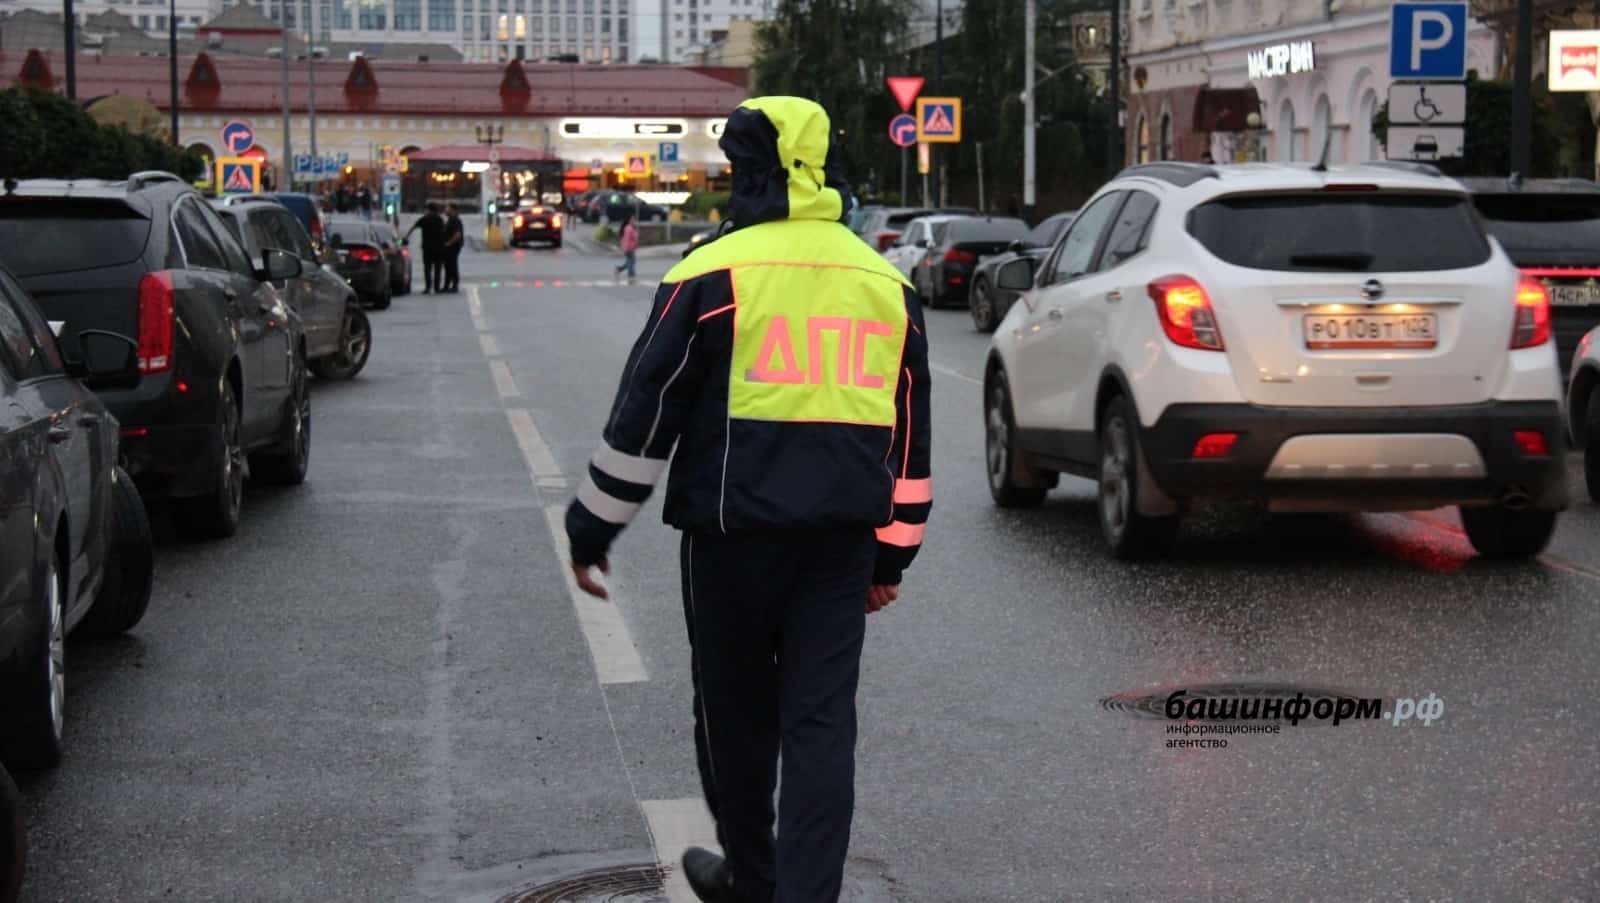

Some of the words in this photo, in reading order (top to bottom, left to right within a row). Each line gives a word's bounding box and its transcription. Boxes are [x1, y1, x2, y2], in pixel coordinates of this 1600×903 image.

[1247, 44, 1290, 80] МАСТЕР
[1411, 10, 1453, 71] P
[744, 314, 894, 389] ДПС
